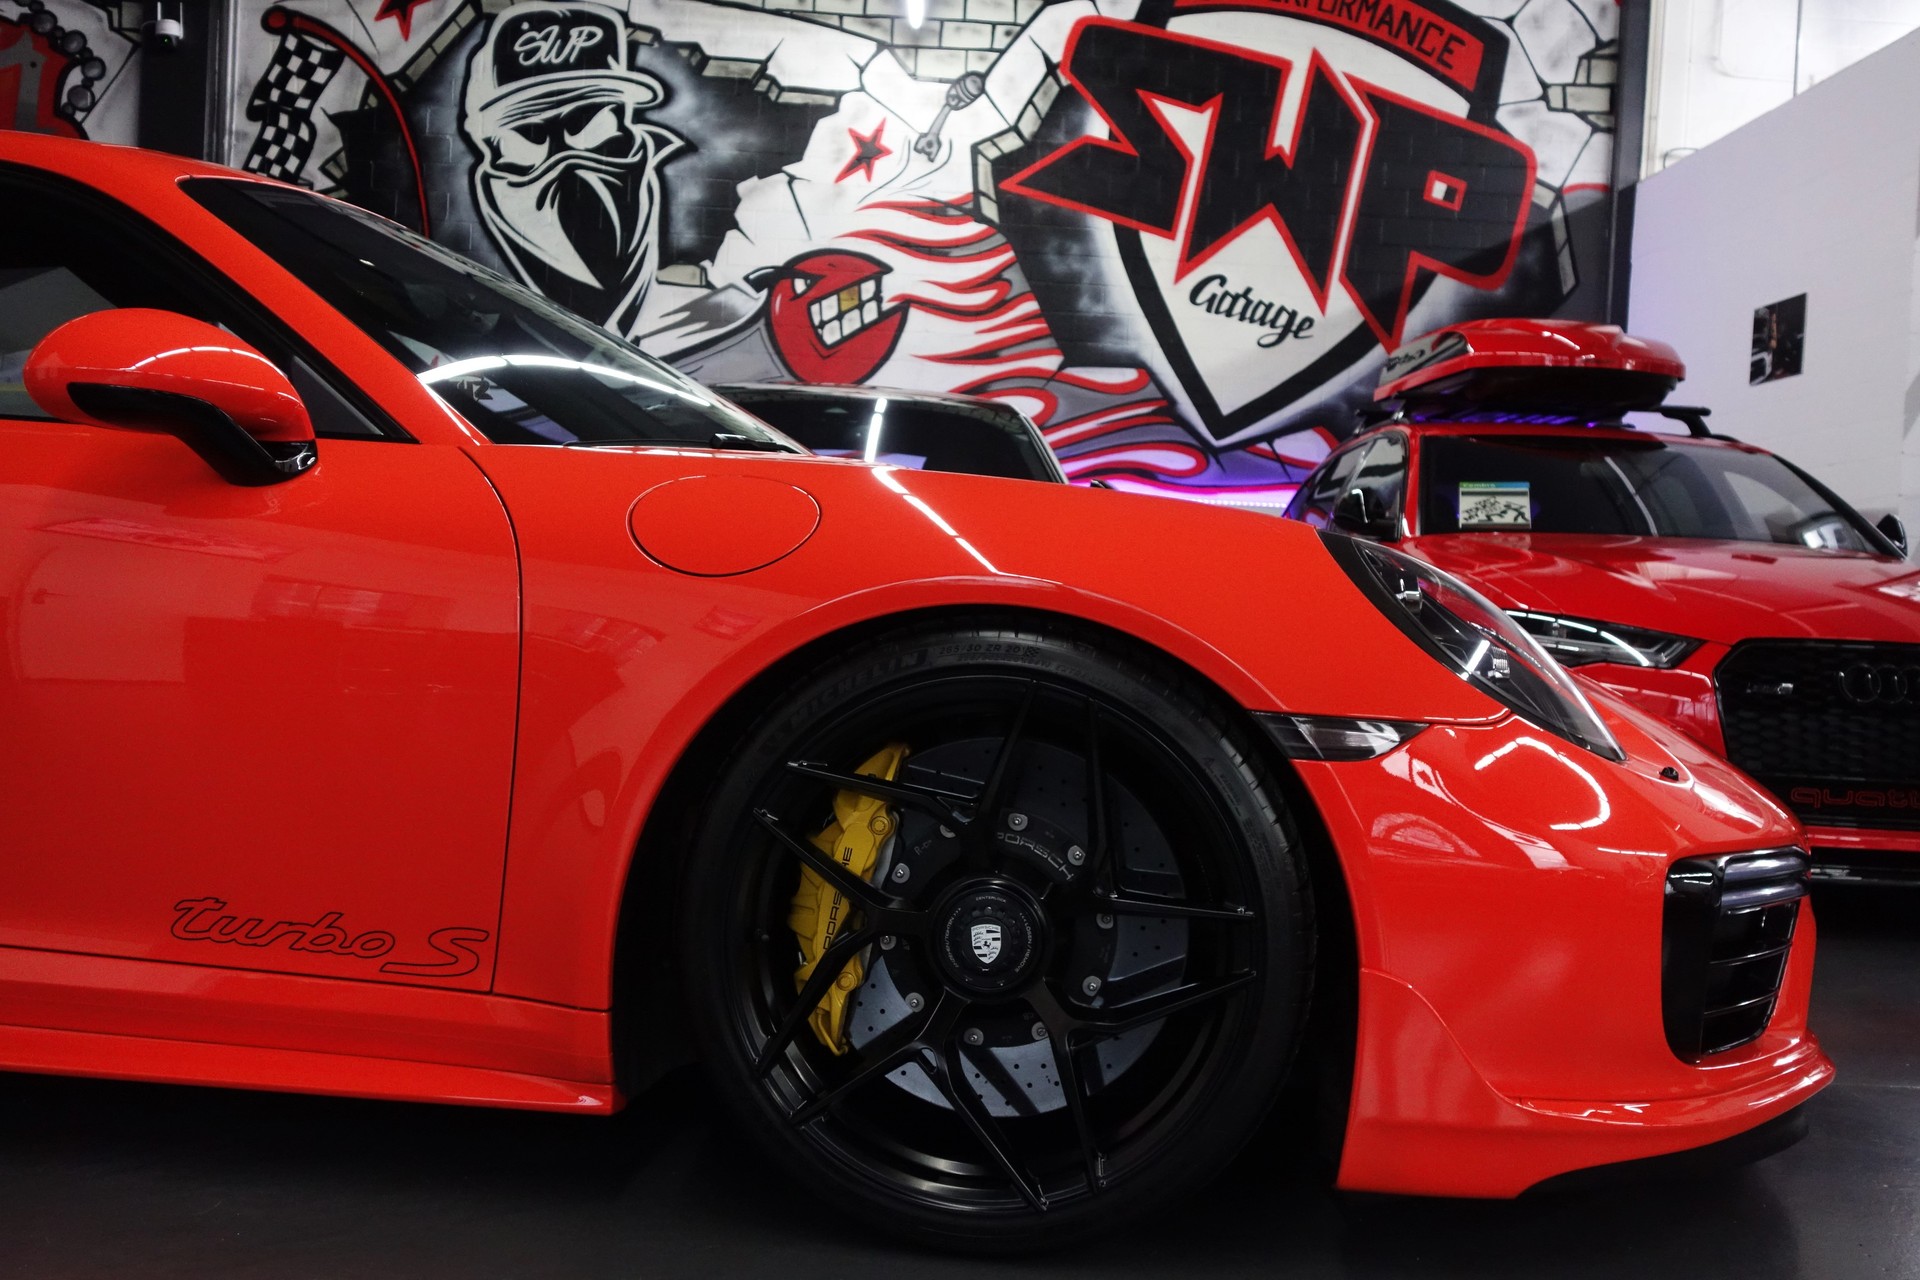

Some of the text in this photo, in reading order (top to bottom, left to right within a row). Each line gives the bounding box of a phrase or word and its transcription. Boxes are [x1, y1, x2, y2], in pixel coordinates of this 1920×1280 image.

[513, 24, 604, 66] SWP
[1000, 16, 1538, 356] SWP
[1189, 274, 1315, 348] Garage
[996, 831, 1075, 882] PORSCH
[170, 897, 490, 978] turbo S
